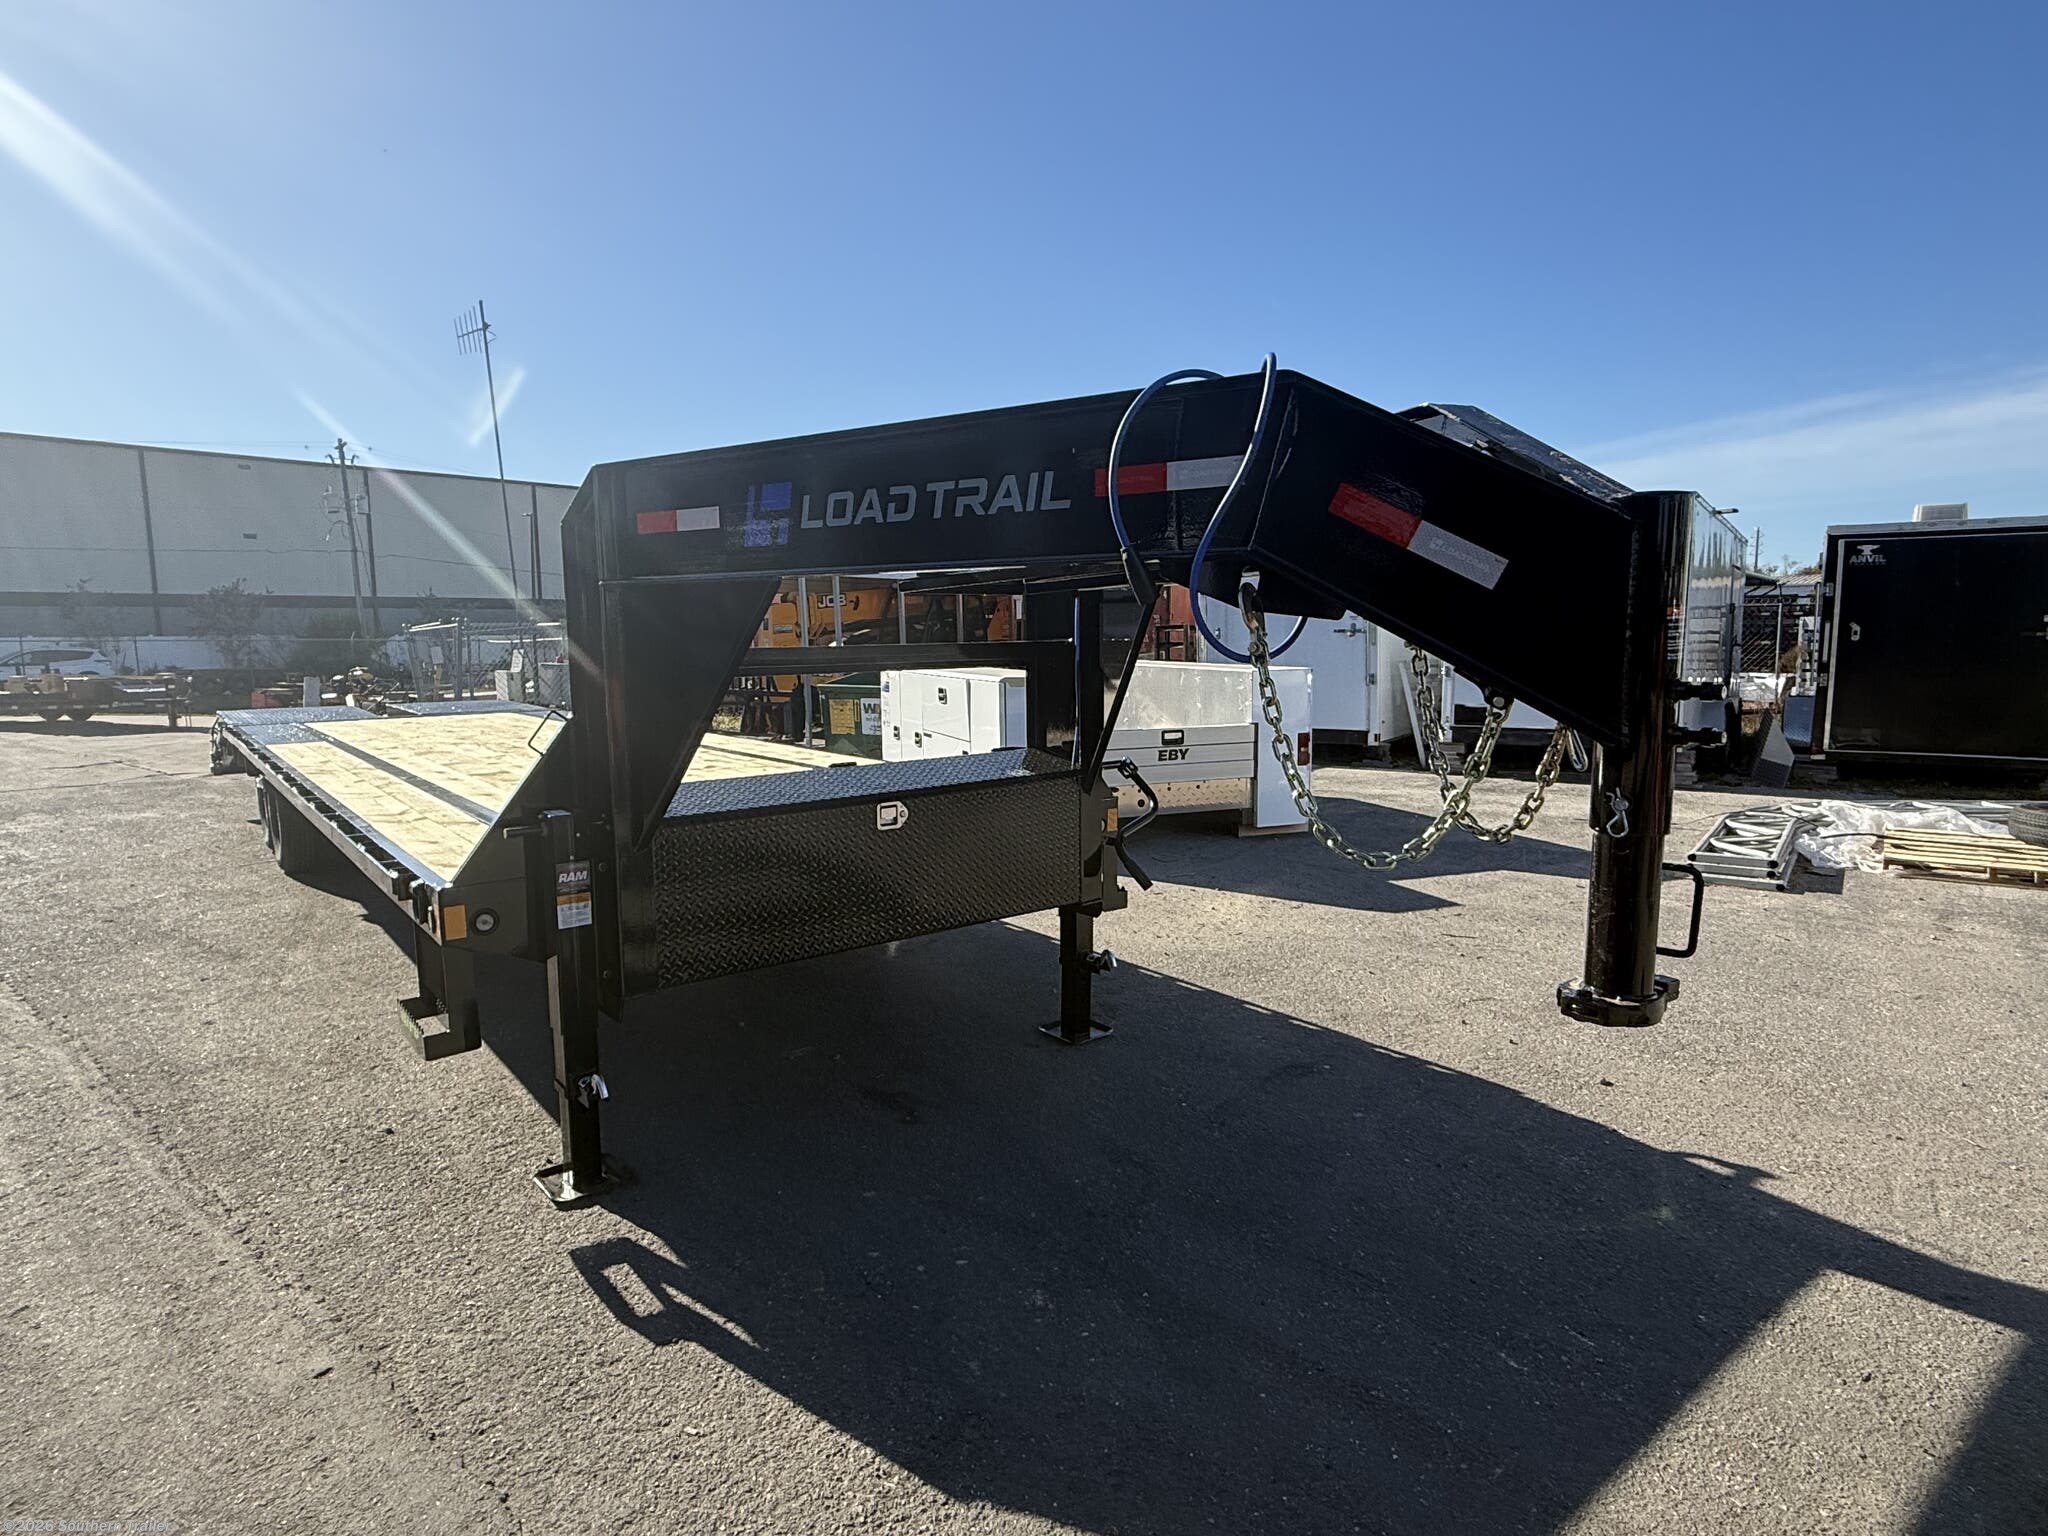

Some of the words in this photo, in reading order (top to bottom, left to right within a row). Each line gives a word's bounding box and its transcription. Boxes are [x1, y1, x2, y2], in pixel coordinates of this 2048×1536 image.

[800, 485, 918, 529] LOAD
[926, 470, 1072, 519] TRAIL
[1849, 554, 1887, 563] ANVIL
[817, 594, 847, 608] JCB
[1157, 747, 1190, 762] EBY
[558, 870, 588, 883] RAM
